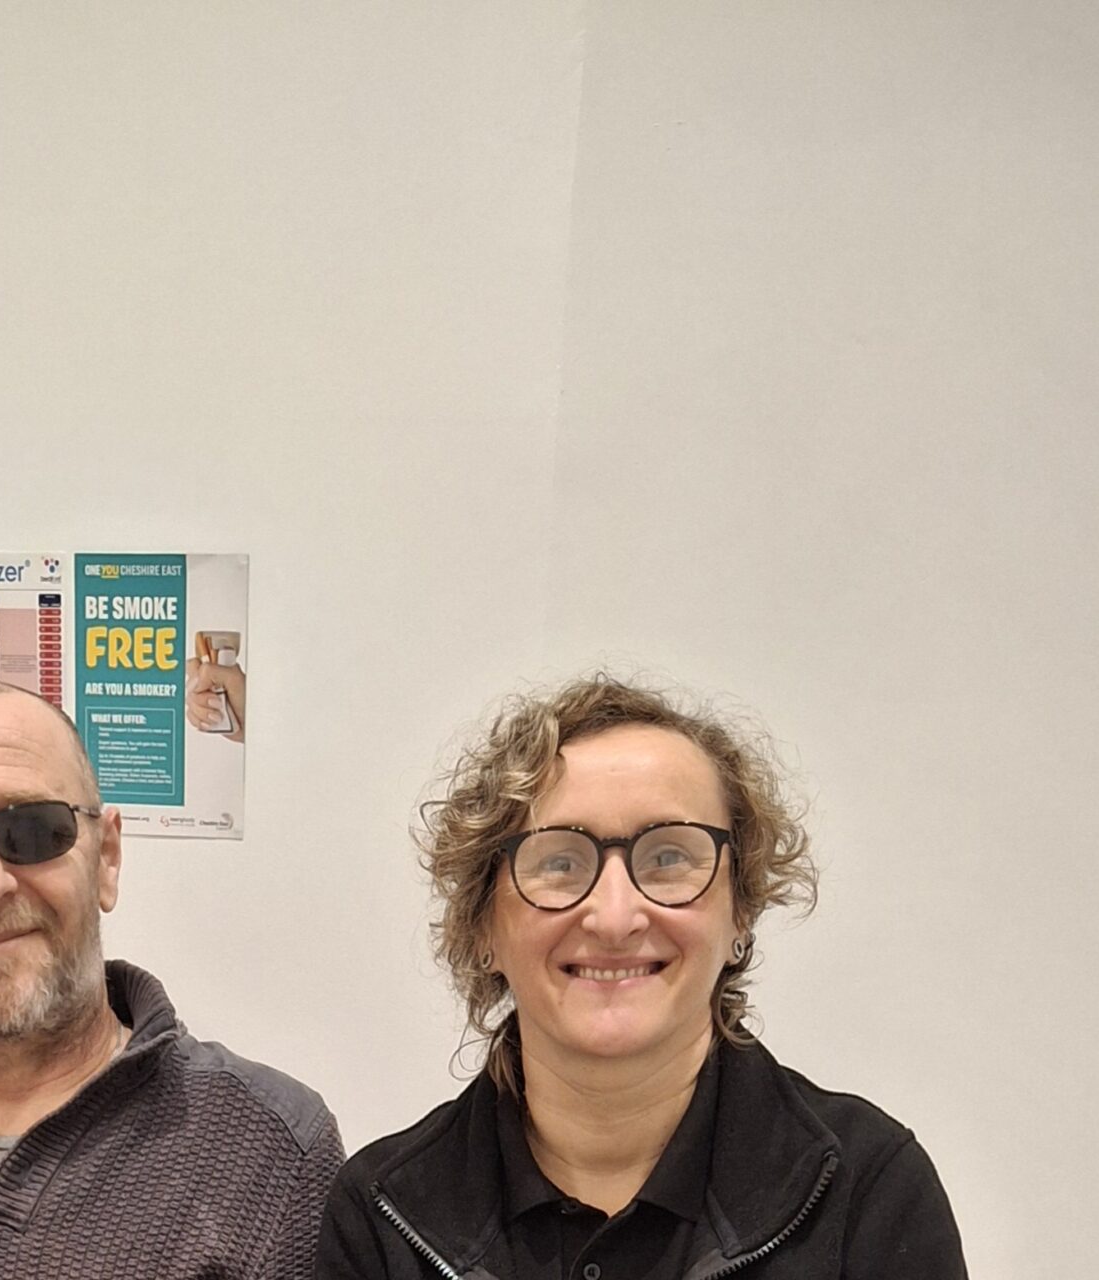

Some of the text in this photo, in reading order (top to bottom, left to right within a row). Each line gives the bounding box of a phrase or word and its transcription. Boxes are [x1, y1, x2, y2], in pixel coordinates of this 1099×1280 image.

[85, 564, 182, 579] ONE YOU CHESHIRE EAST
[85, 596, 109, 620] BE
[112, 596, 178, 621] SMOKE
[86, 626, 179, 670] FREE
[85, 682, 178, 697] ARE YOU A SMOKER?
[91, 713, 111, 723] WHAT
[112, 714, 122, 724] WE
